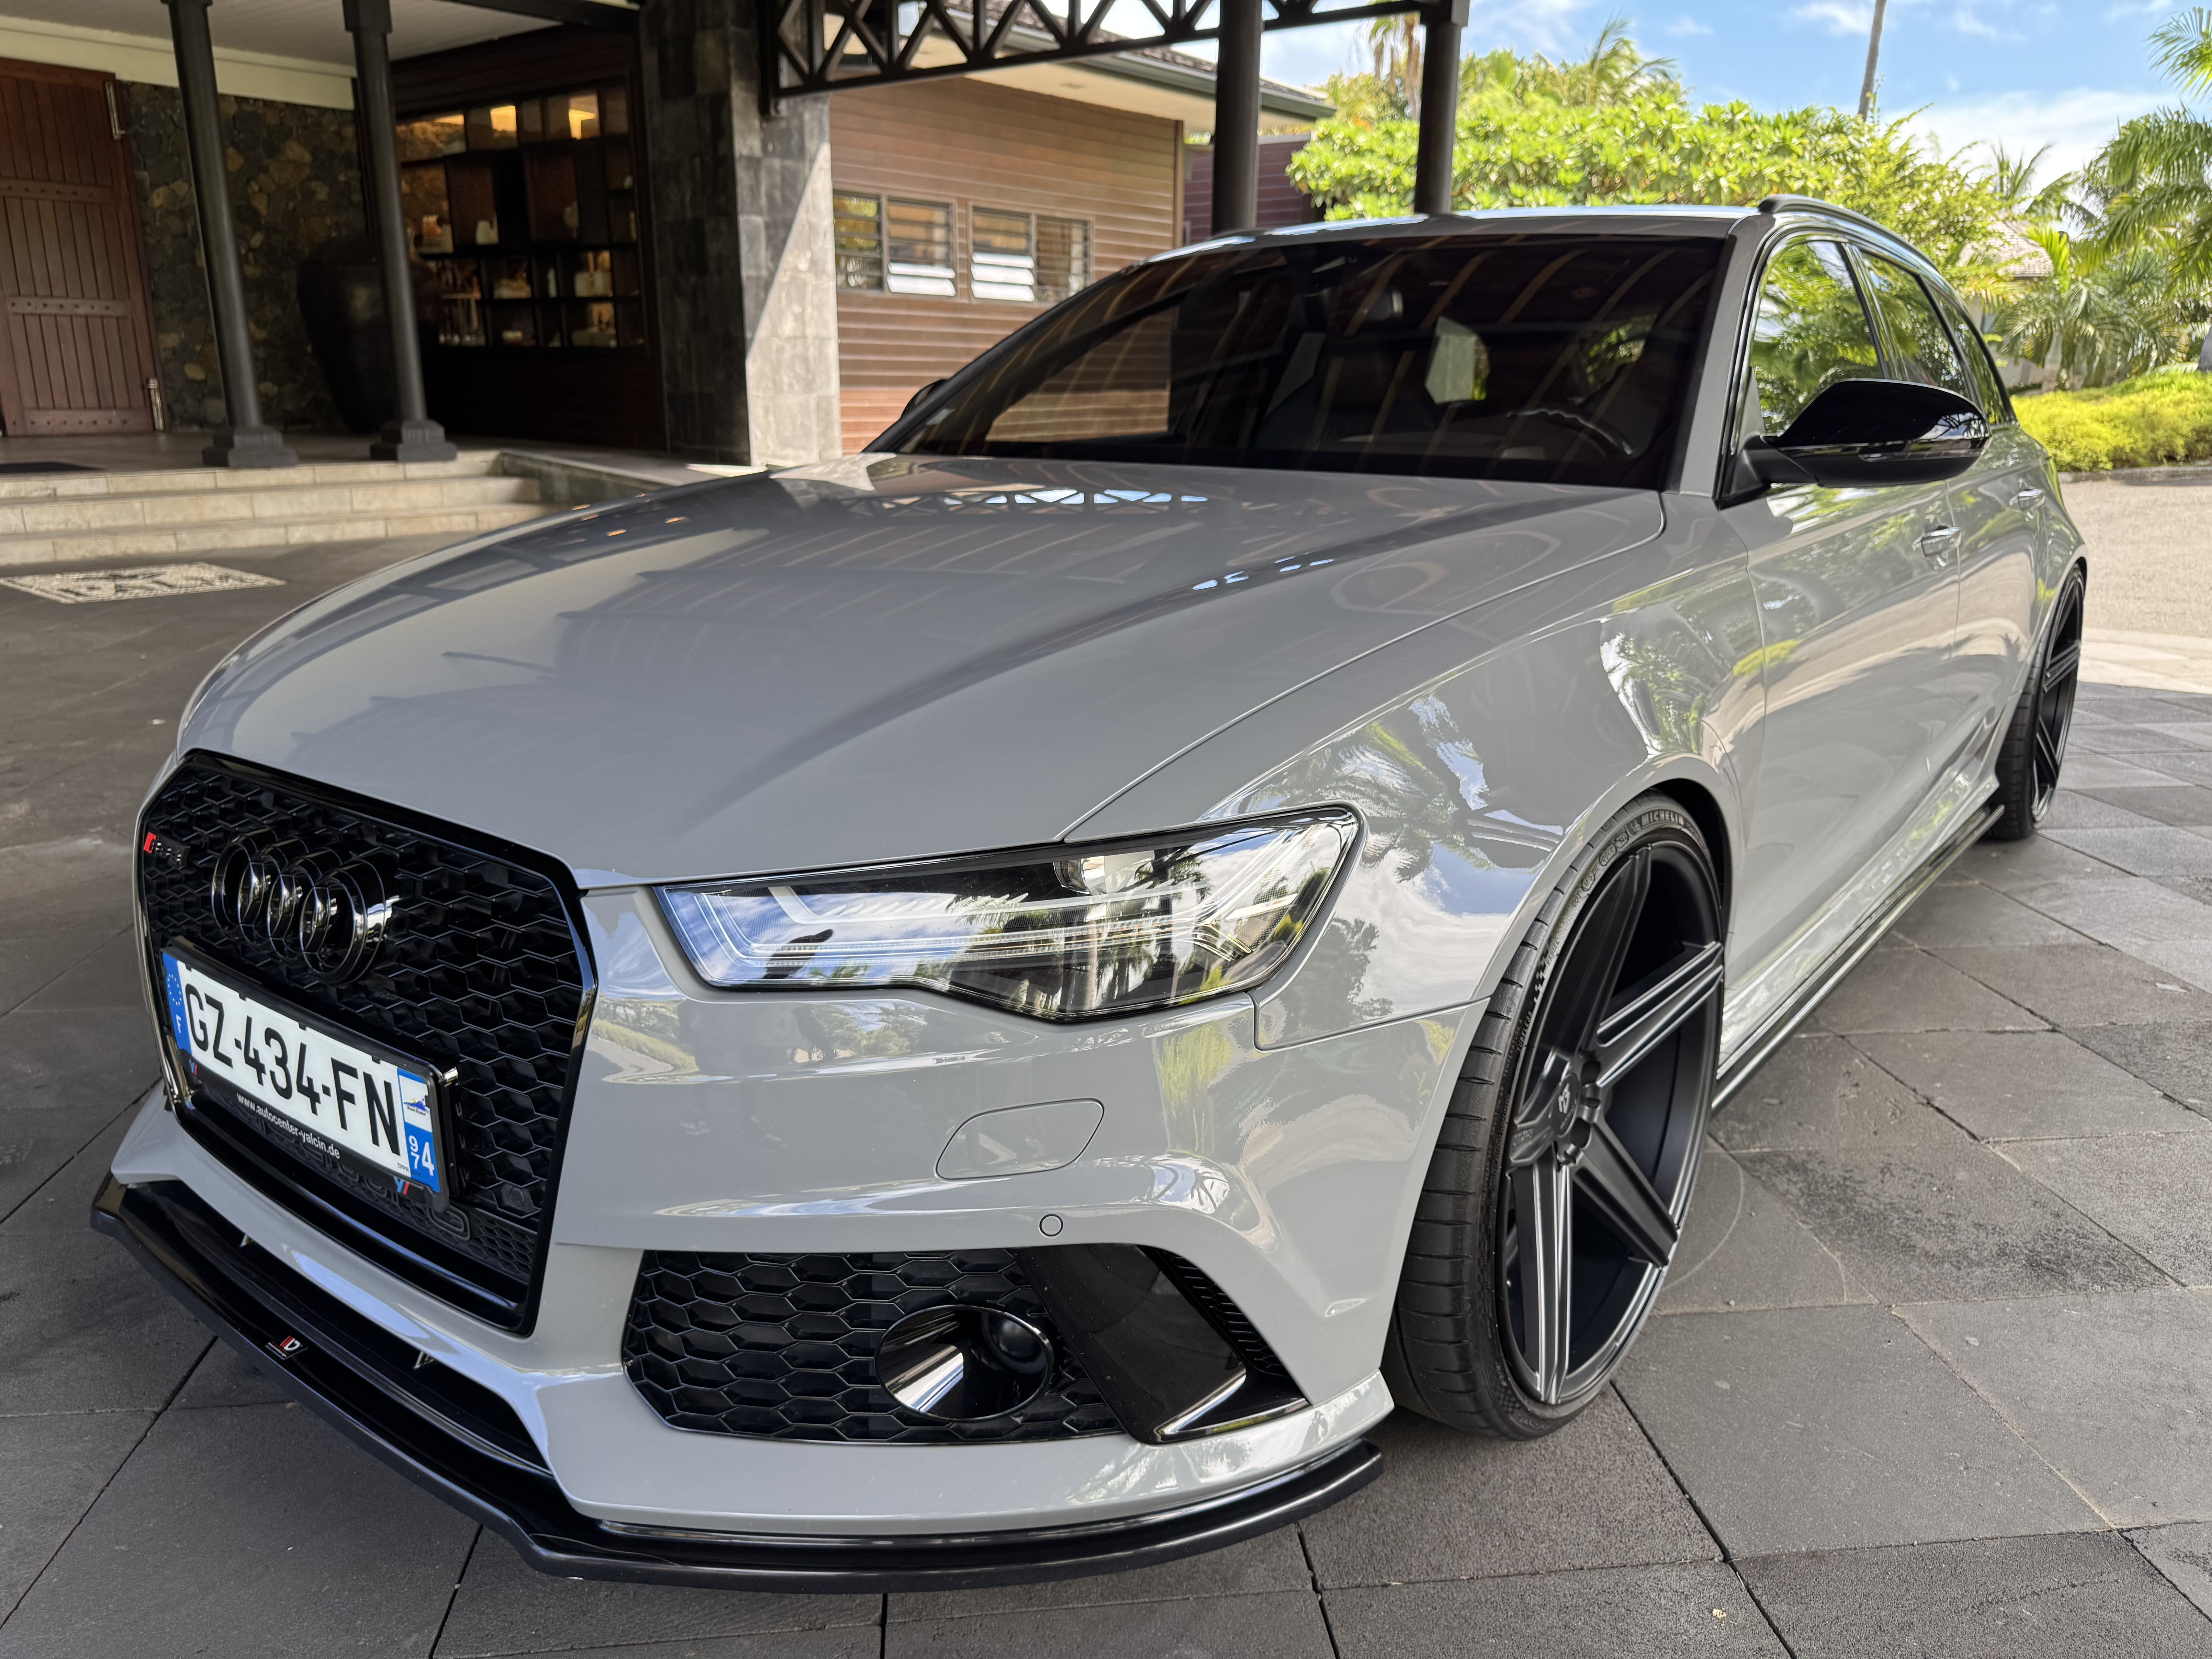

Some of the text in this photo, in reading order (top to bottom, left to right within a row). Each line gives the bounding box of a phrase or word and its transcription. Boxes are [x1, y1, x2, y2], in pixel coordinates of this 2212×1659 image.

[1641, 810, 1684, 826] MICHELIN
[1546, 940, 1560, 966] RADIAL
[176, 1014, 182, 1034] F
[1517, 1011, 1532, 1052] TUBELESS
[185, 983, 401, 1157] GZ-434-FN
[1503, 1027, 1520, 1077] TEMPERATURE
[237, 1092, 340, 1159] www.autocenter-yalcin.de
